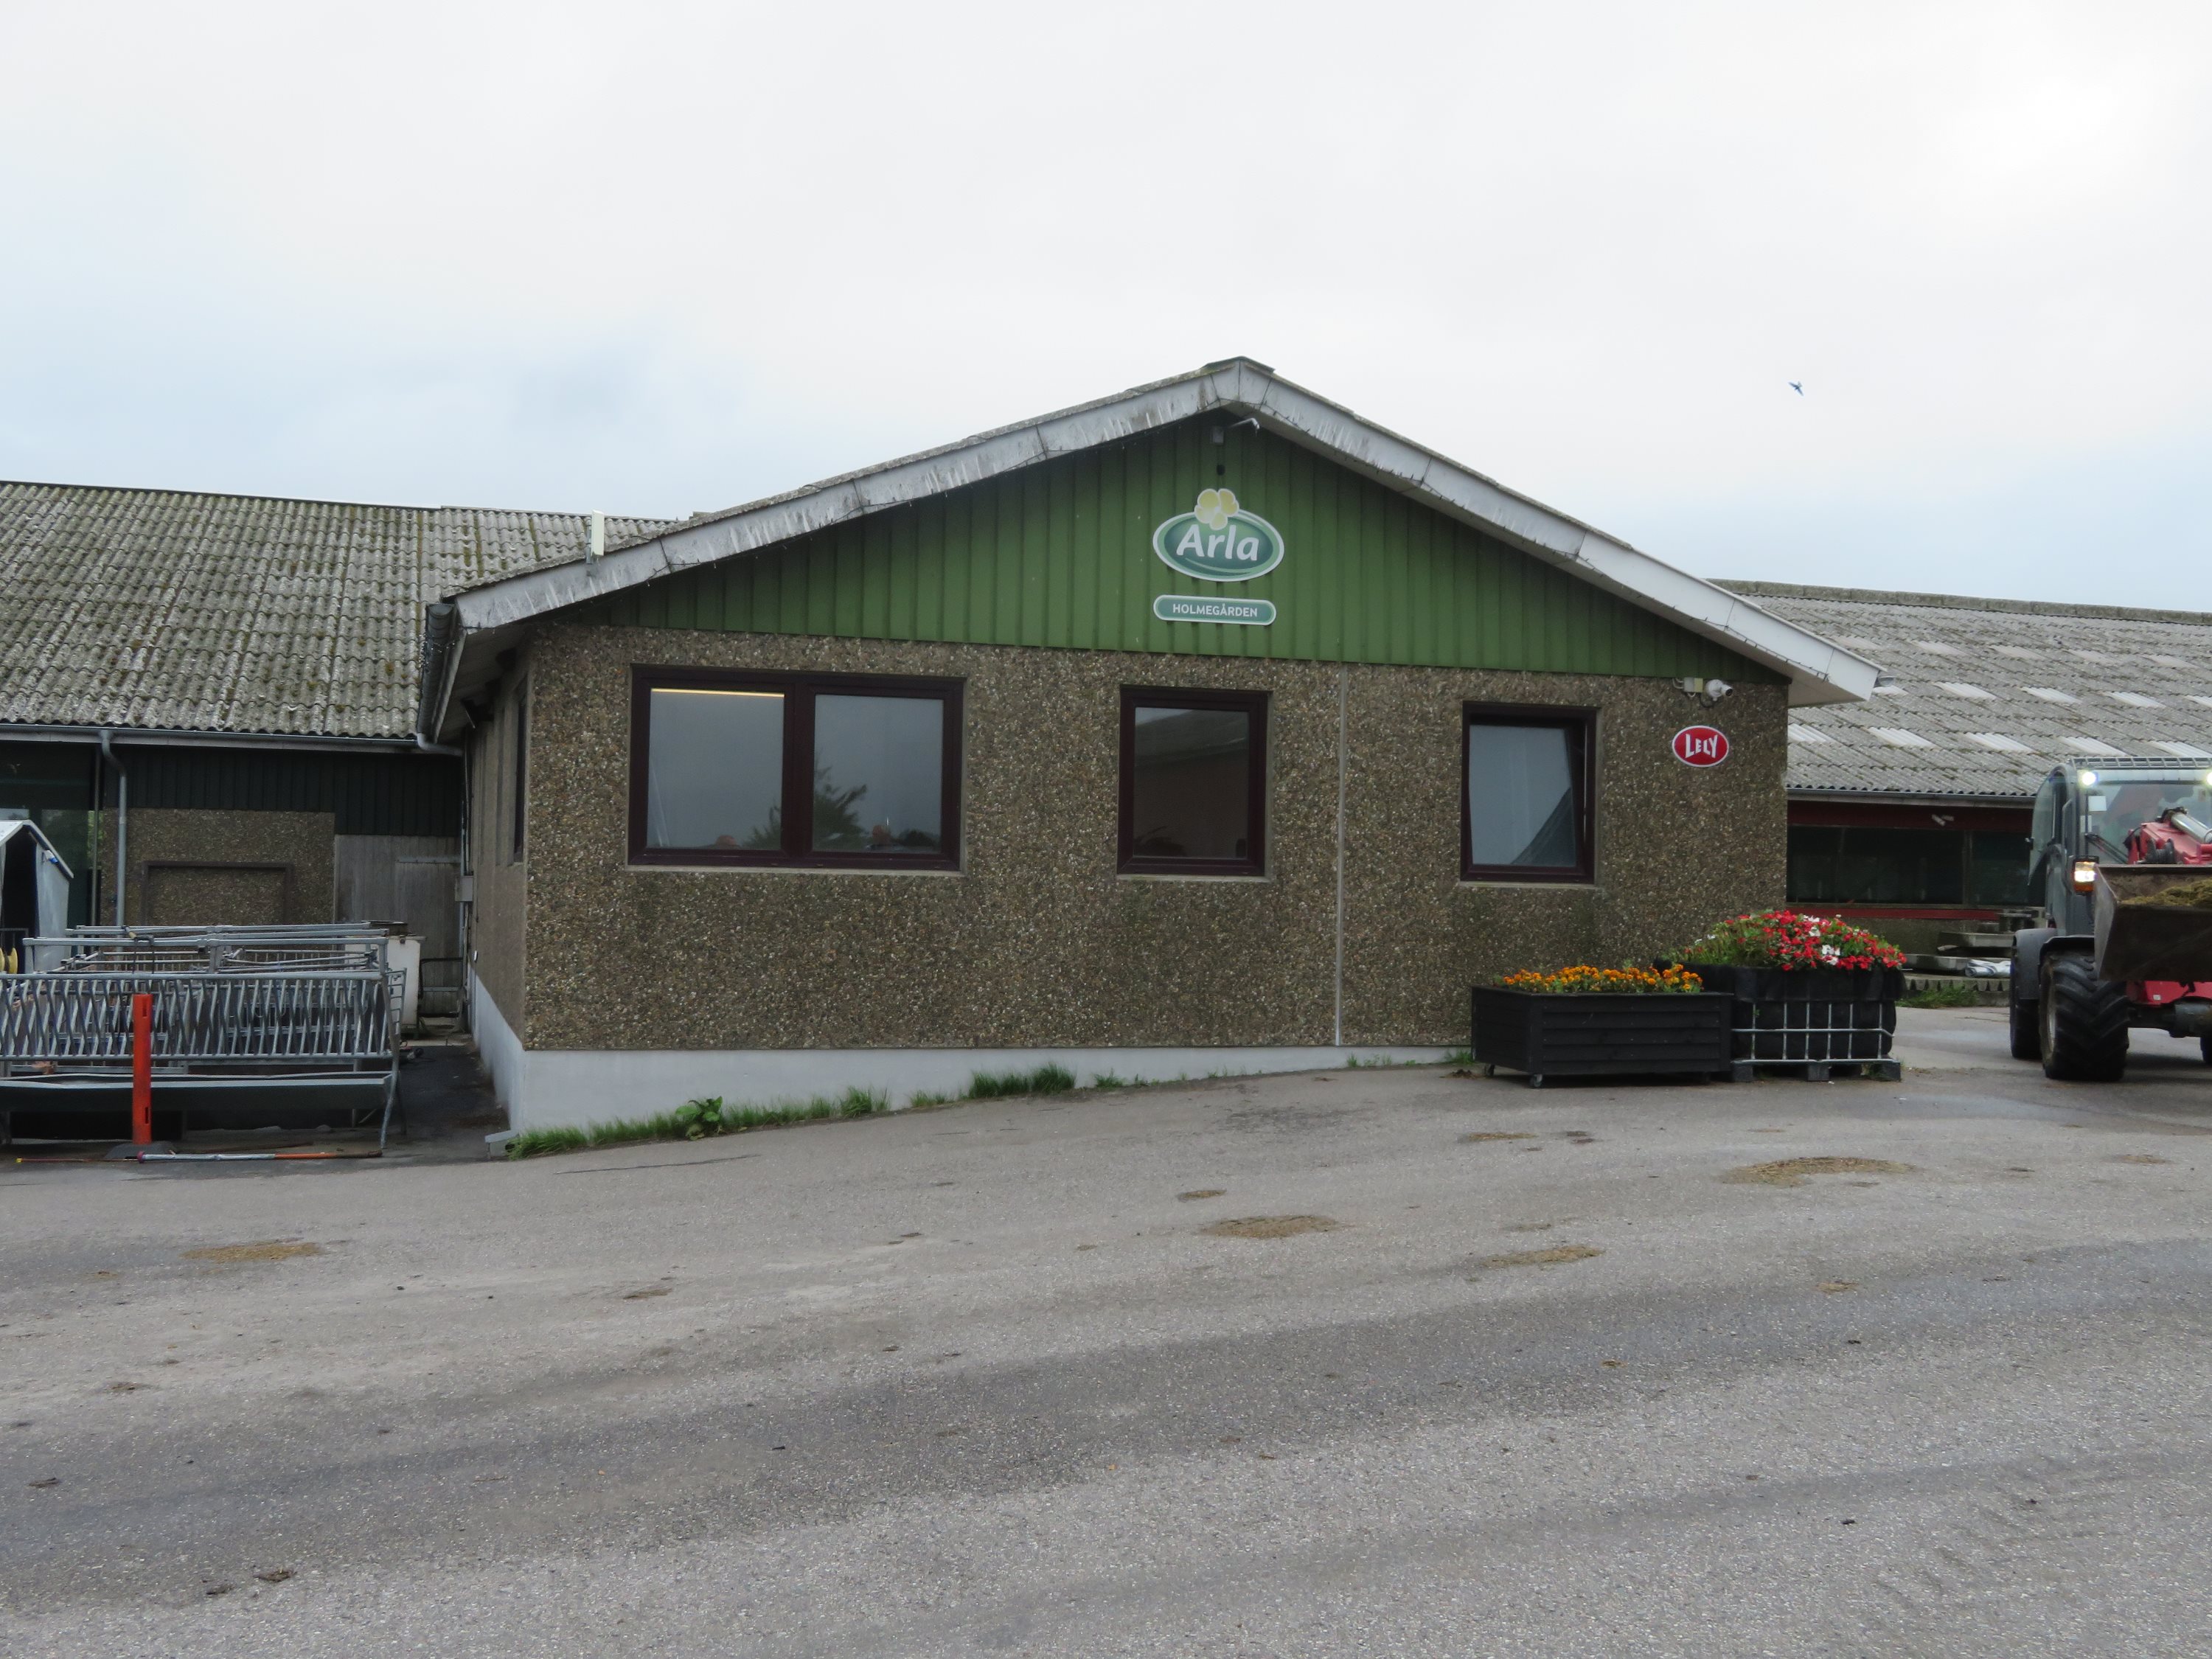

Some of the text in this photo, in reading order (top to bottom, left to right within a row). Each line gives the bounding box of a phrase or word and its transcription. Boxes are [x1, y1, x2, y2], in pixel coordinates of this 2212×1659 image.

[1176, 524, 1259, 561] Arla
[1172, 603, 1258, 617] HOLMEGÅRDEN
[1685, 733, 1718, 759] LELY
